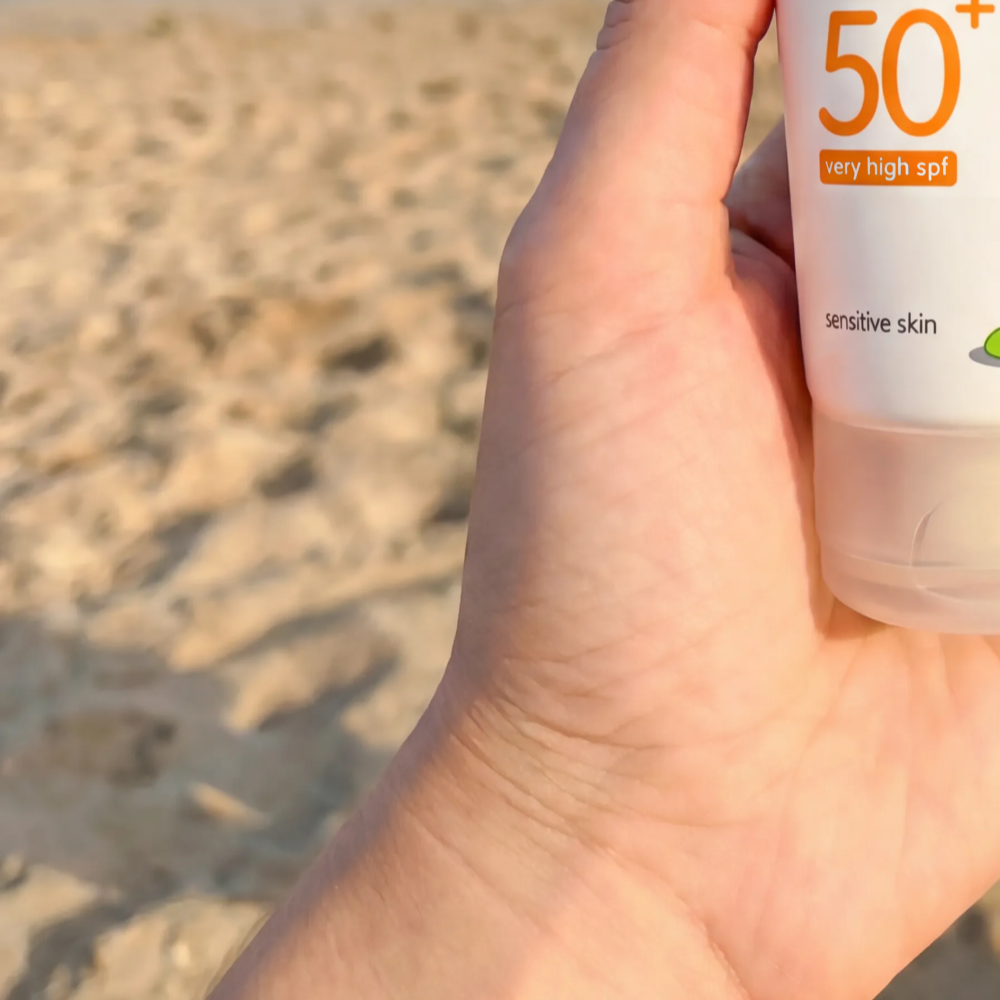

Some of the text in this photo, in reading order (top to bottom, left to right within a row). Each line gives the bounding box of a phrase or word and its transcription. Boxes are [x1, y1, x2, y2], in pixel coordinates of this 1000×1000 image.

[825, 156, 949, 182] very high spf
[826, 310, 936, 334] sensitive skin
